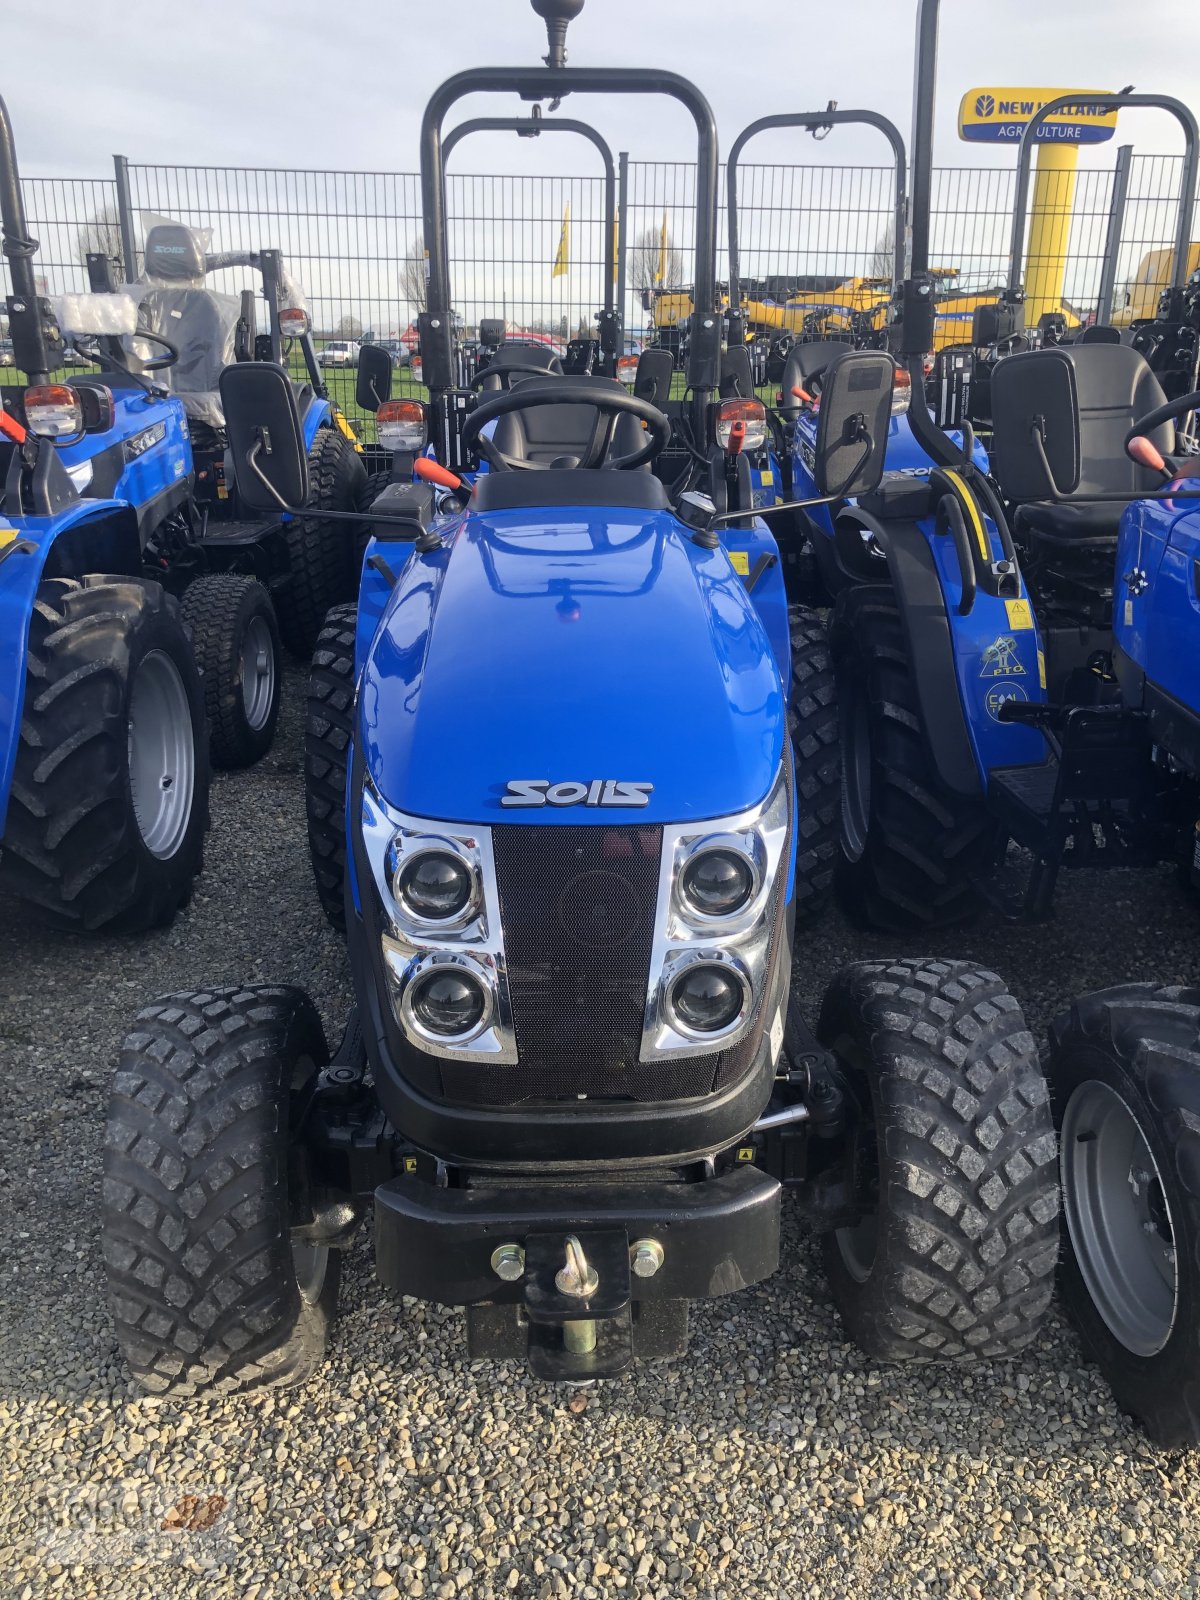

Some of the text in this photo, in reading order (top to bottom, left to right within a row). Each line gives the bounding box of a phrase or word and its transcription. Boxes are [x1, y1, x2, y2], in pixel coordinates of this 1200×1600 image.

[998, 101, 1107, 116] NEW LLAND
[998, 126, 1081, 138] AGRULTURE
[900, 467, 933, 476] Sol
[993, 665, 1024, 676] PTO
